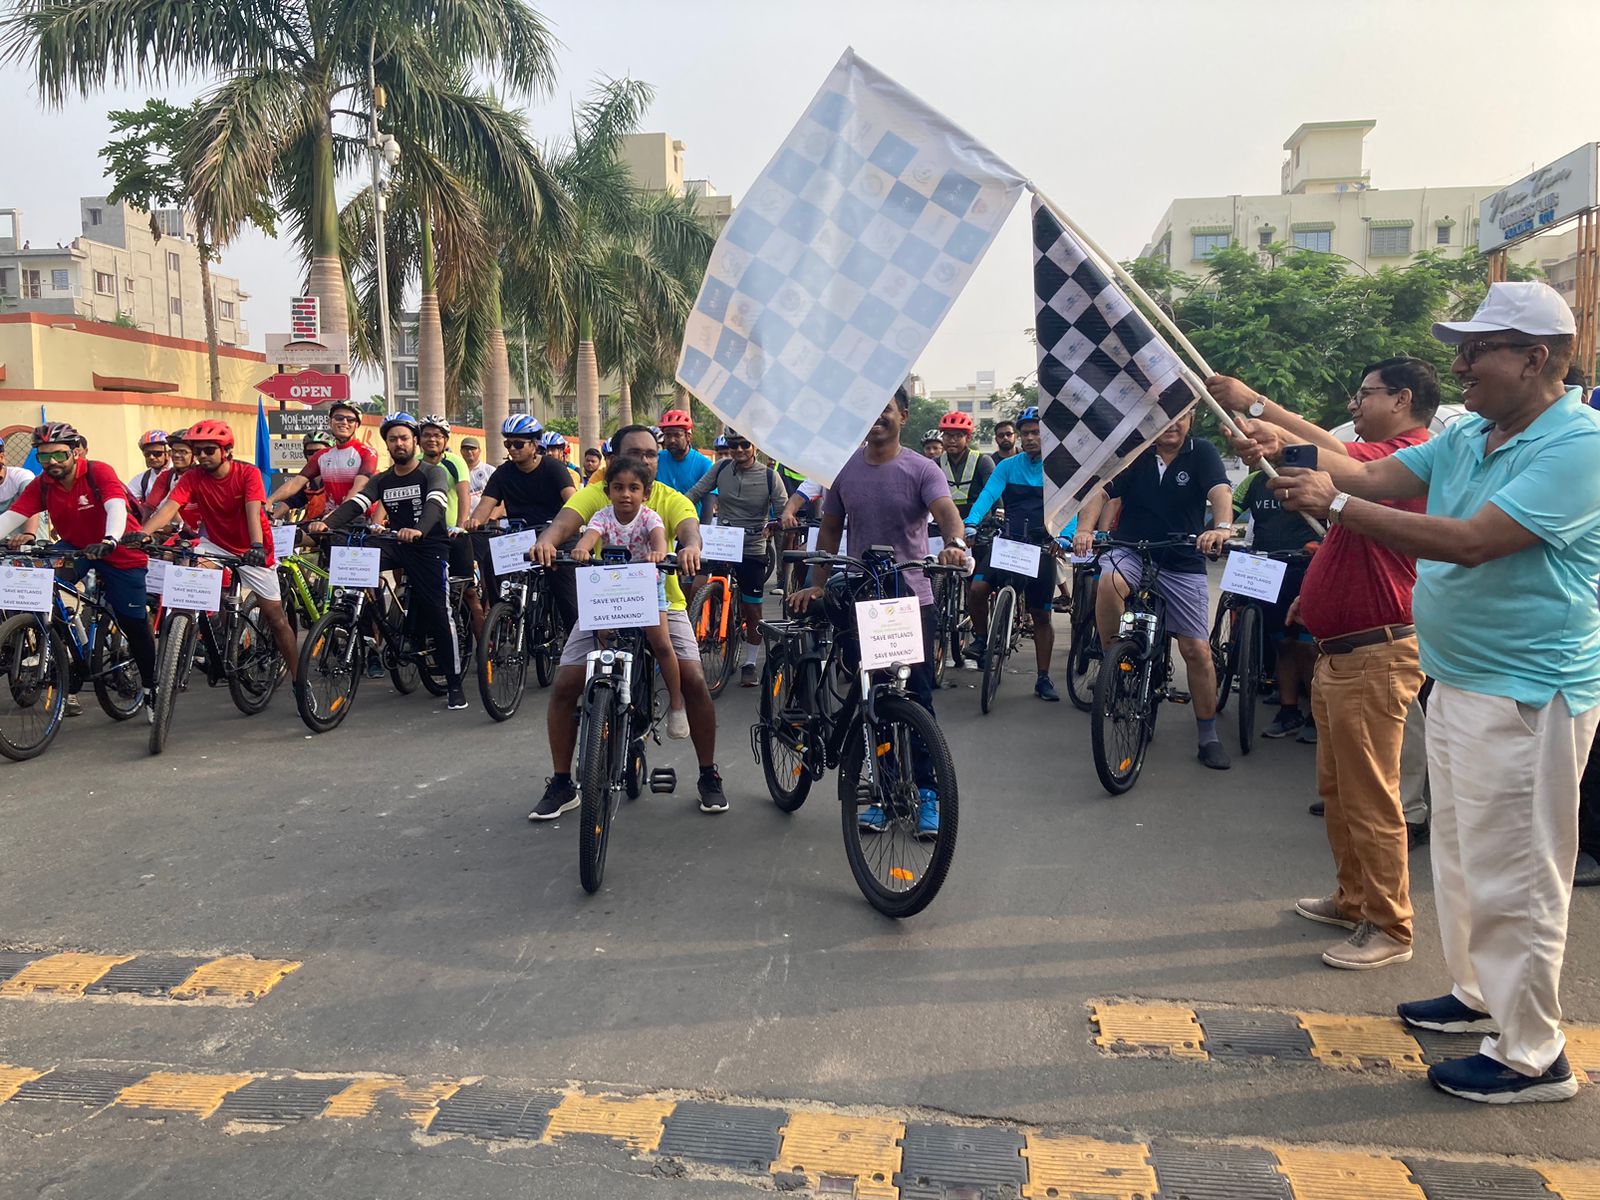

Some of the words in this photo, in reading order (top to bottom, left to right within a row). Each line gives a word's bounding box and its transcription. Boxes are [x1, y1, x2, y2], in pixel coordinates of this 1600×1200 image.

[290, 386, 332, 397] OPEN
[280, 414, 329, 424] NON-MEMBE
[290, 451, 303, 459] RUS
[384, 487, 420, 499] STRENGTH
[1256, 500, 1280, 509] VEL
